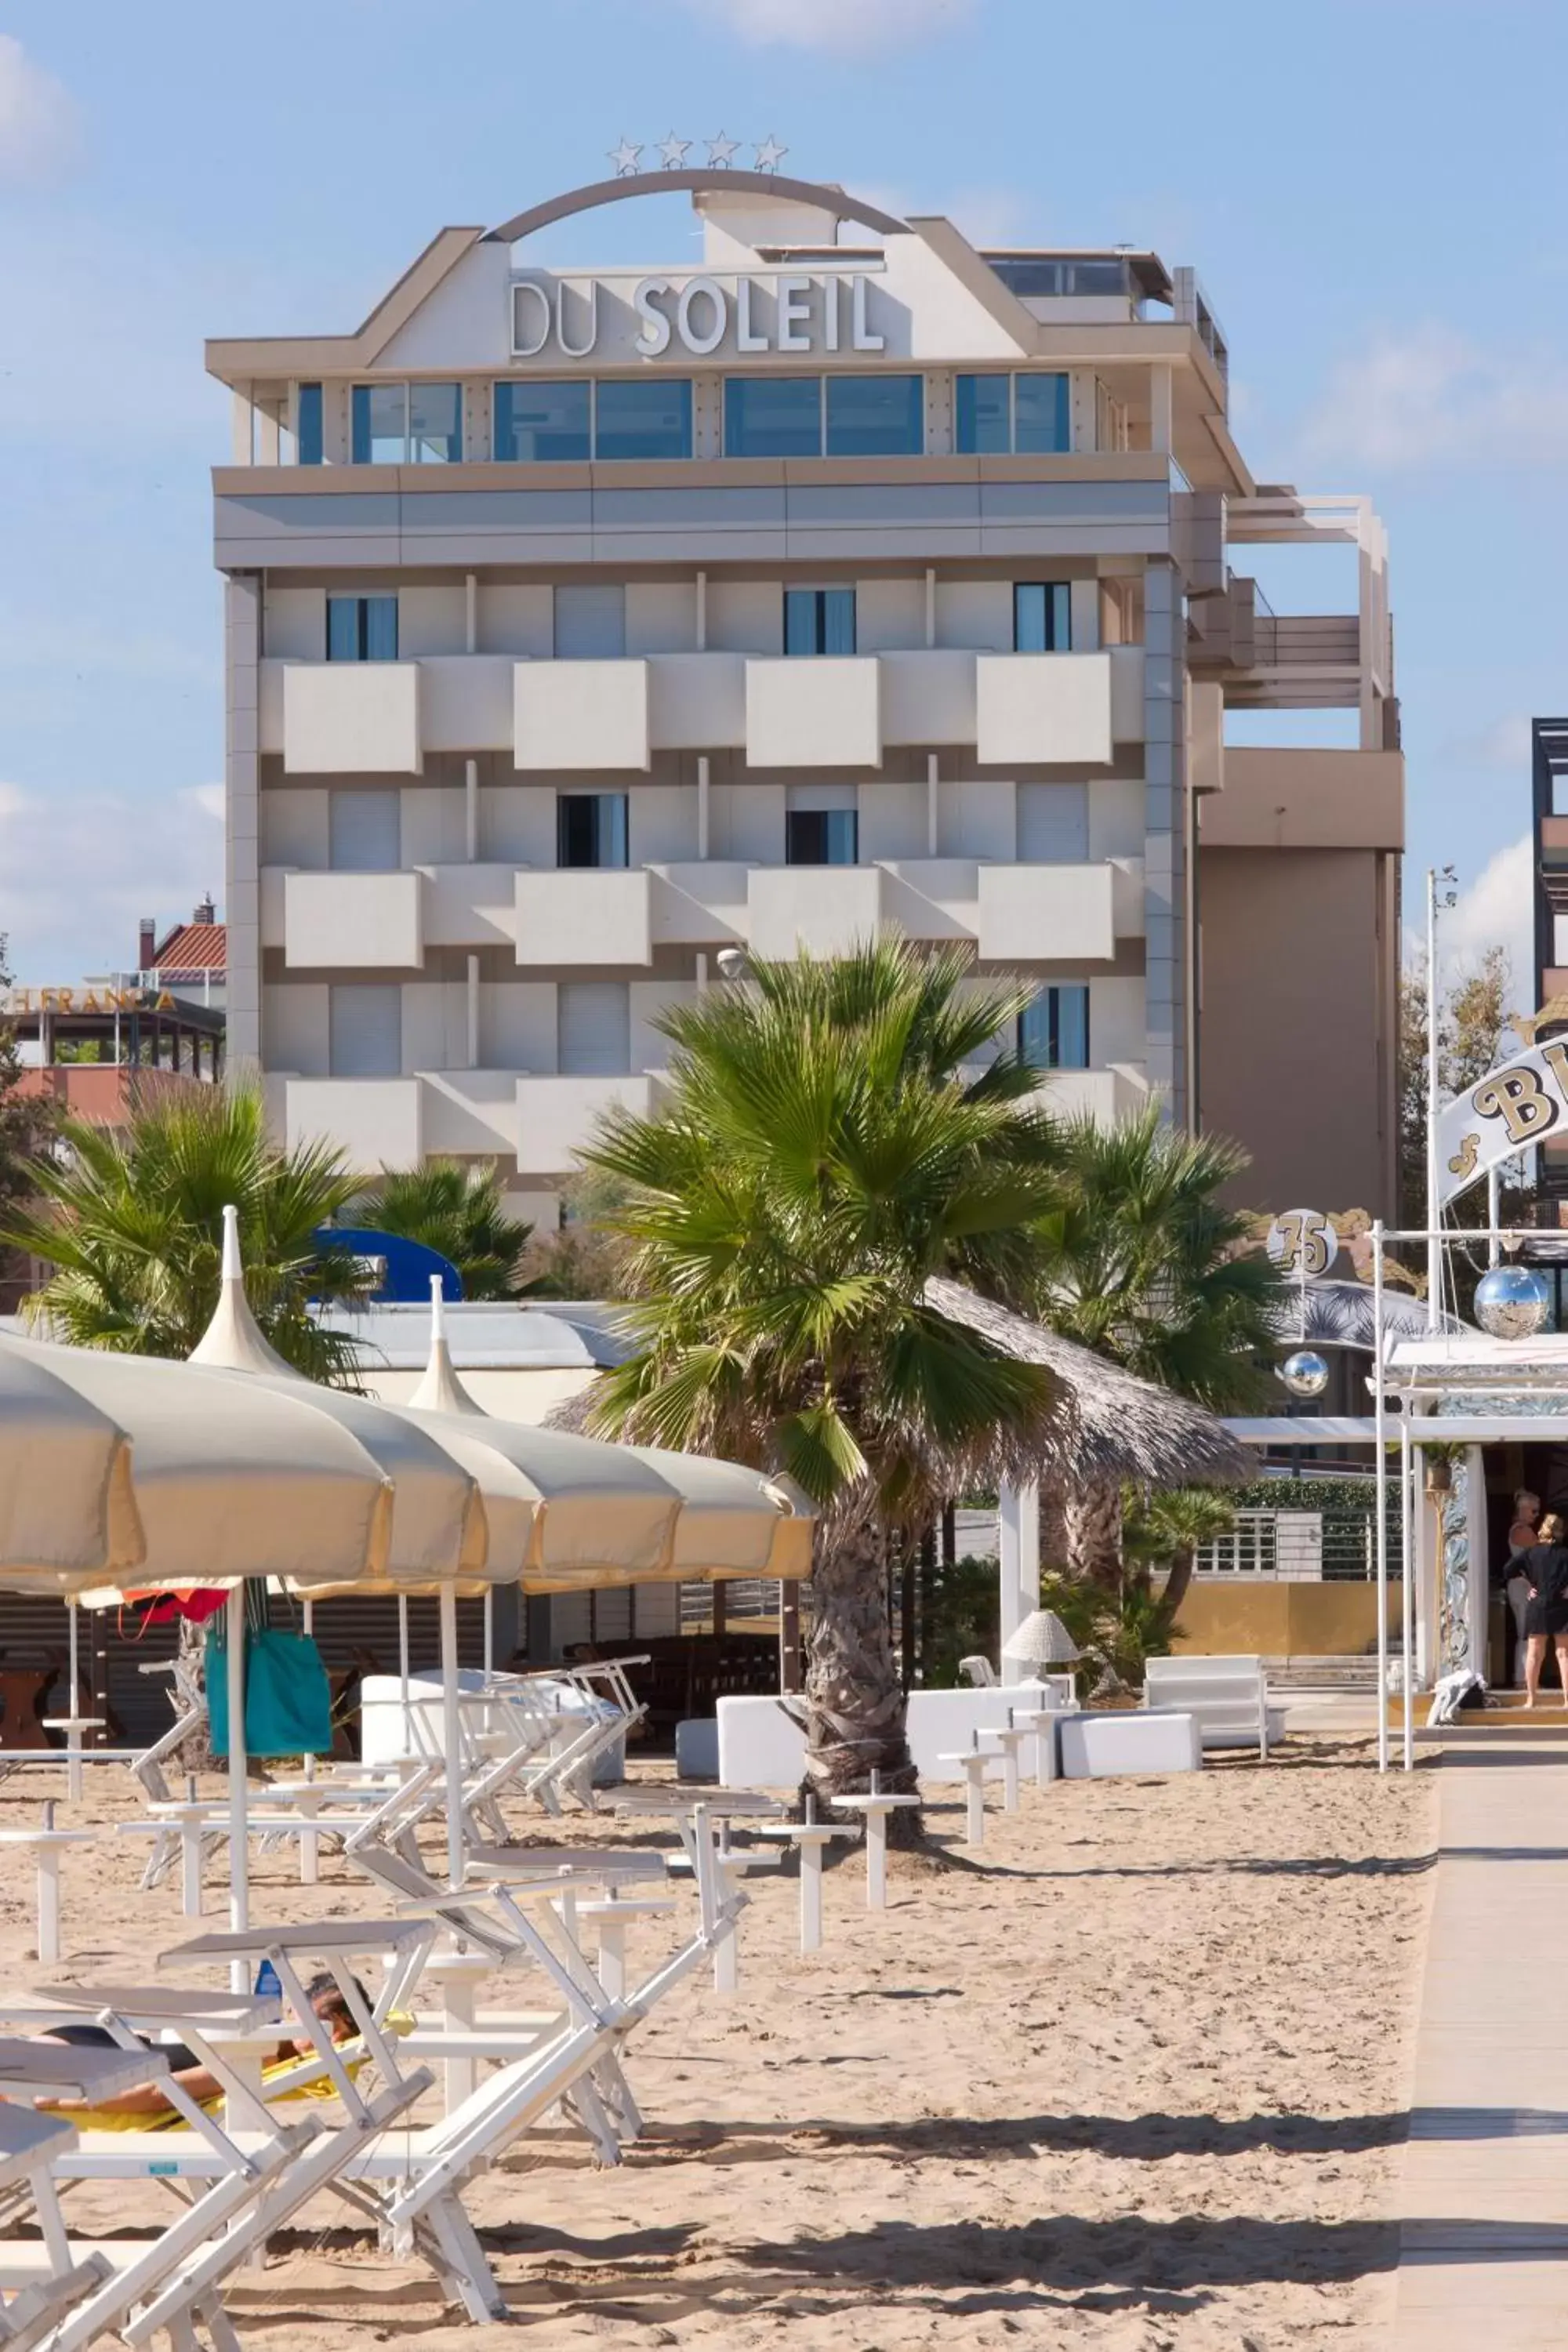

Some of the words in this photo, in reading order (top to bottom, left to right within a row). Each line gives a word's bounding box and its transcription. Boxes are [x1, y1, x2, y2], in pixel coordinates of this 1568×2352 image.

[510, 280, 597, 358] DU
[633, 275, 884, 356] SOLEIL
[1276, 1215, 1328, 1273] 75
